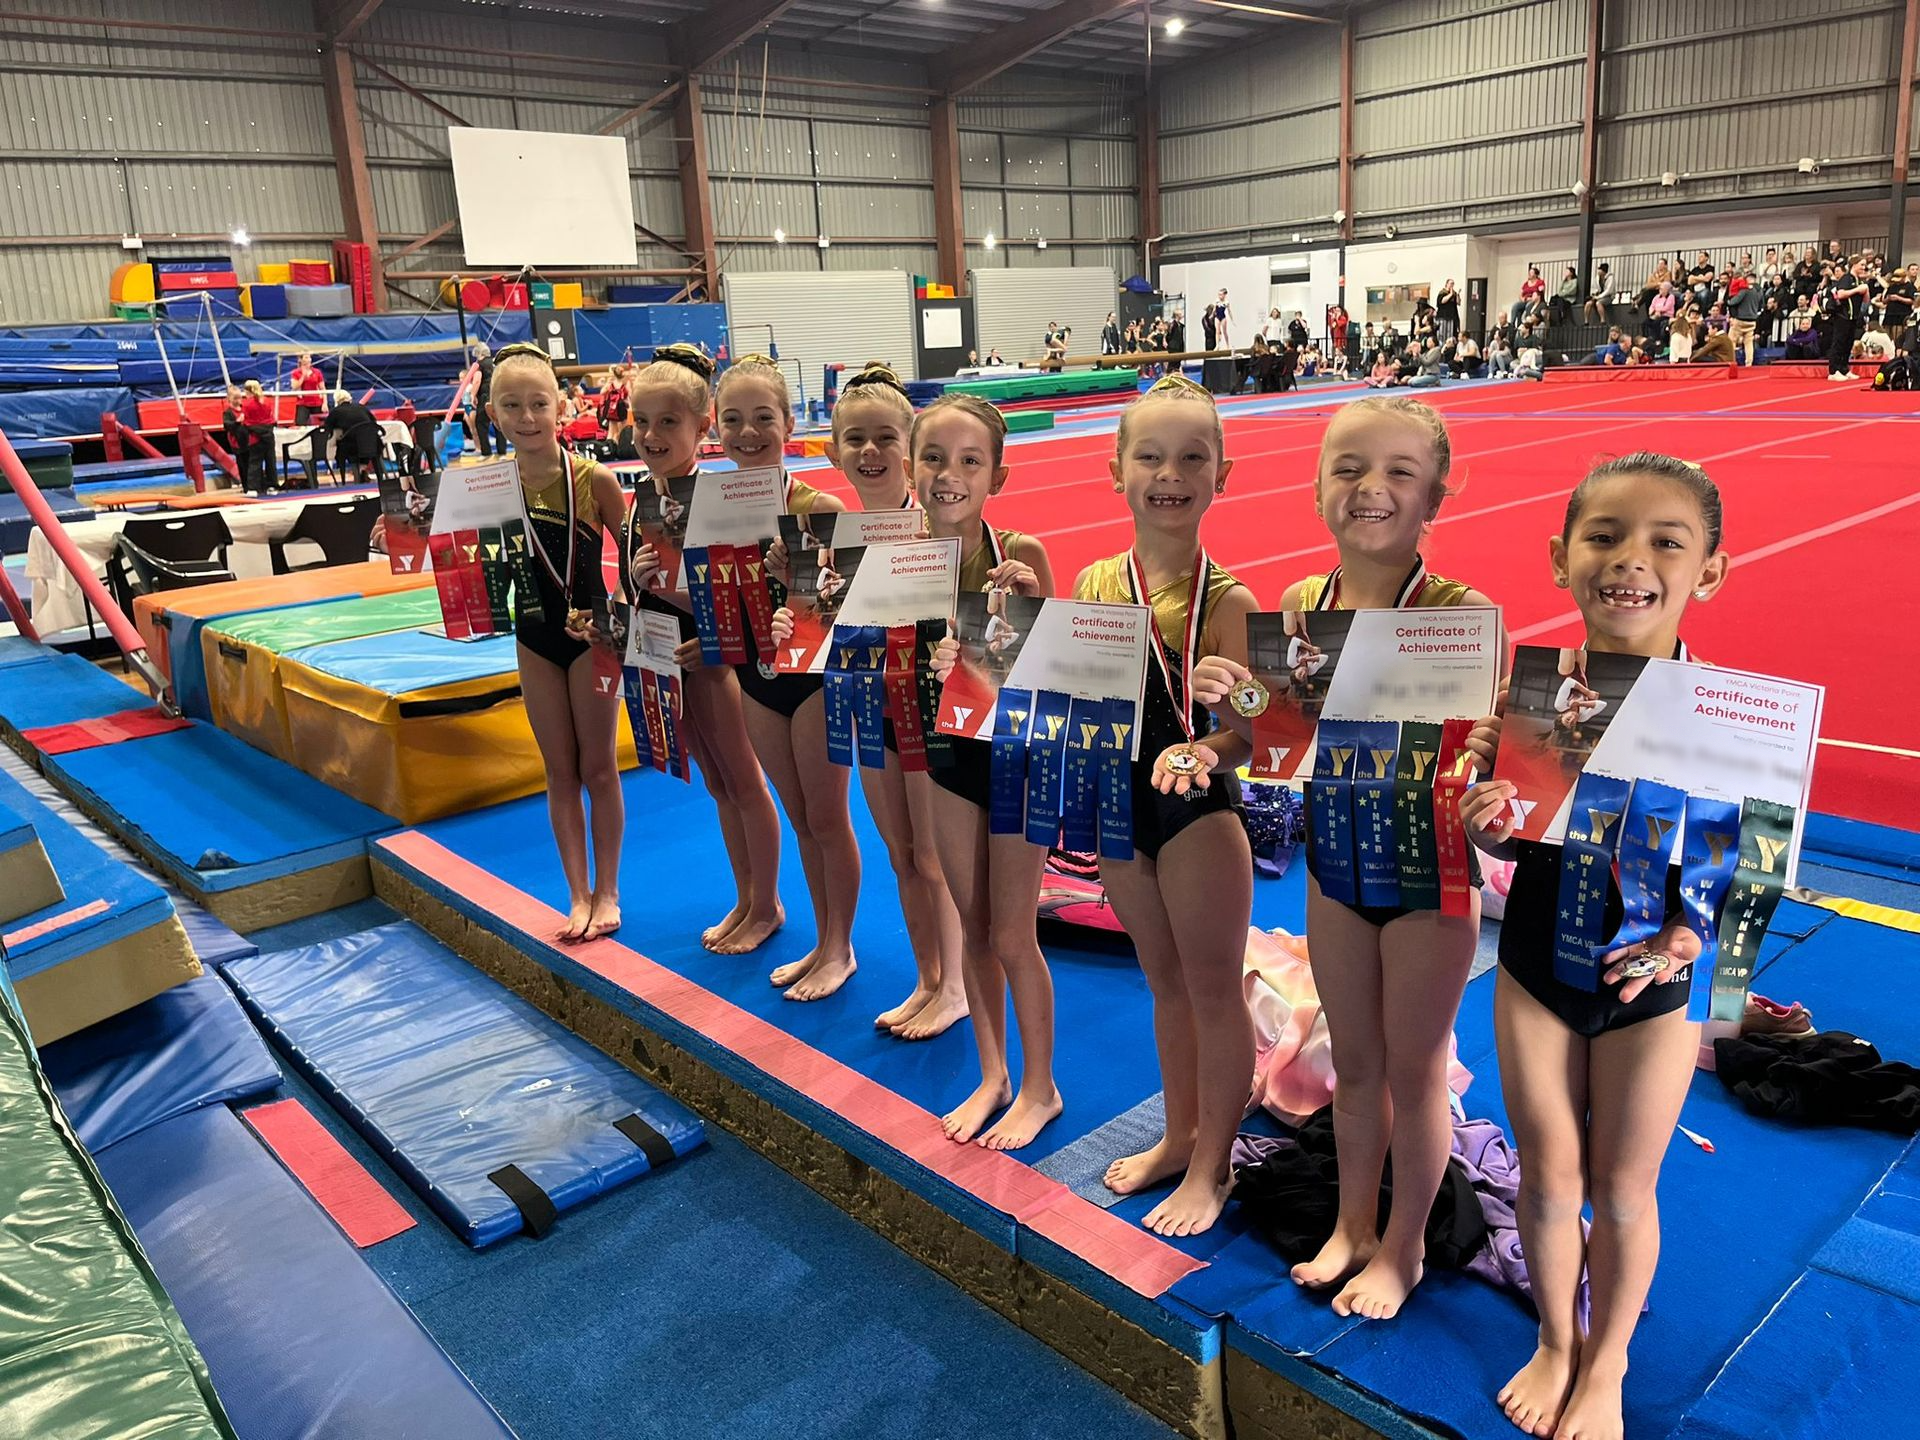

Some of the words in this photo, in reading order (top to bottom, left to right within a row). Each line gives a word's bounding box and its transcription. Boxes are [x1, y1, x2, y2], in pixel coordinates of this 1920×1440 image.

[721, 479, 763, 490] Certificate
[860, 522, 903, 532] Certificate
[904, 521, 913, 529] of
[862, 533, 913, 542] Achievement
[890, 553, 937, 564] Certificate
[938, 551, 948, 560] of
[890, 564, 947, 575] Achievement
[693, 564, 708, 584] Y
[718, 564, 733, 584] Y
[745, 562, 761, 583] Y
[1072, 616, 1125, 629] Certificate
[1126, 621, 1136, 630] of
[1395, 626, 1466, 638] Certificate
[1468, 625, 1482, 636] of
[1072, 630, 1135, 643] Achievement
[1398, 642, 1482, 653] Achievement
[788, 648, 807, 668] Y
[840, 647, 858, 669] Y
[868, 647, 886, 669] Y
[897, 647, 915, 671] Y
[833, 676, 843, 726] WINNER
[1694, 685, 1779, 710] Certificate
[1783, 703, 1799, 714] of
[1726, 679, 1750, 689] YMCA
[1750, 683, 1780, 695] Victoria
[1781, 689, 1801, 697] Point
[864, 676, 873, 727] WINNER
[898, 679, 913, 729] WINNER
[941, 721, 954, 729] the
[953, 706, 974, 730] Y
[1007, 709, 1028, 736] Y
[1045, 715, 1066, 741] Y
[1694, 703, 1796, 732] Achievement
[1068, 741, 1081, 749] the
[1080, 723, 1100, 750] Y
[1101, 741, 1113, 749] the
[1111, 723, 1131, 750] Y
[1268, 747, 1291, 773] Y
[1329, 747, 1354, 777] Y
[1358, 771, 1372, 779] the
[1370, 749, 1395, 779] Y
[1397, 771, 1411, 780] the
[1411, 751, 1435, 781] Y
[1040, 749, 1051, 801] WINNER
[1110, 758, 1119, 813] WINNER
[1325, 786, 1337, 850] WINNER
[1369, 790, 1382, 854] WINNER
[1407, 791, 1419, 858] WINNER
[1445, 788, 1455, 858] WINNER
[1492, 818, 1504, 827] th
[1508, 798, 1538, 830] Y
[1569, 830, 1588, 842] the
[1587, 808, 1619, 844] Y
[1645, 814, 1676, 850] Y
[1687, 855, 1706, 865] the
[1703, 831, 1734, 867] Y
[1739, 858, 1758, 870] the
[1754, 834, 1788, 873] Y
[1364, 862, 1384, 870] YMCA
[1401, 865, 1421, 874] YMCA
[1575, 854, 1594, 928] WINNER
[1732, 883, 1766, 957] WINNER
[1561, 933, 1583, 946] YMCA
[1557, 949, 1595, 967] Invitational
[1719, 967, 1737, 976] YMCA
[1737, 967, 1748, 978] VP
